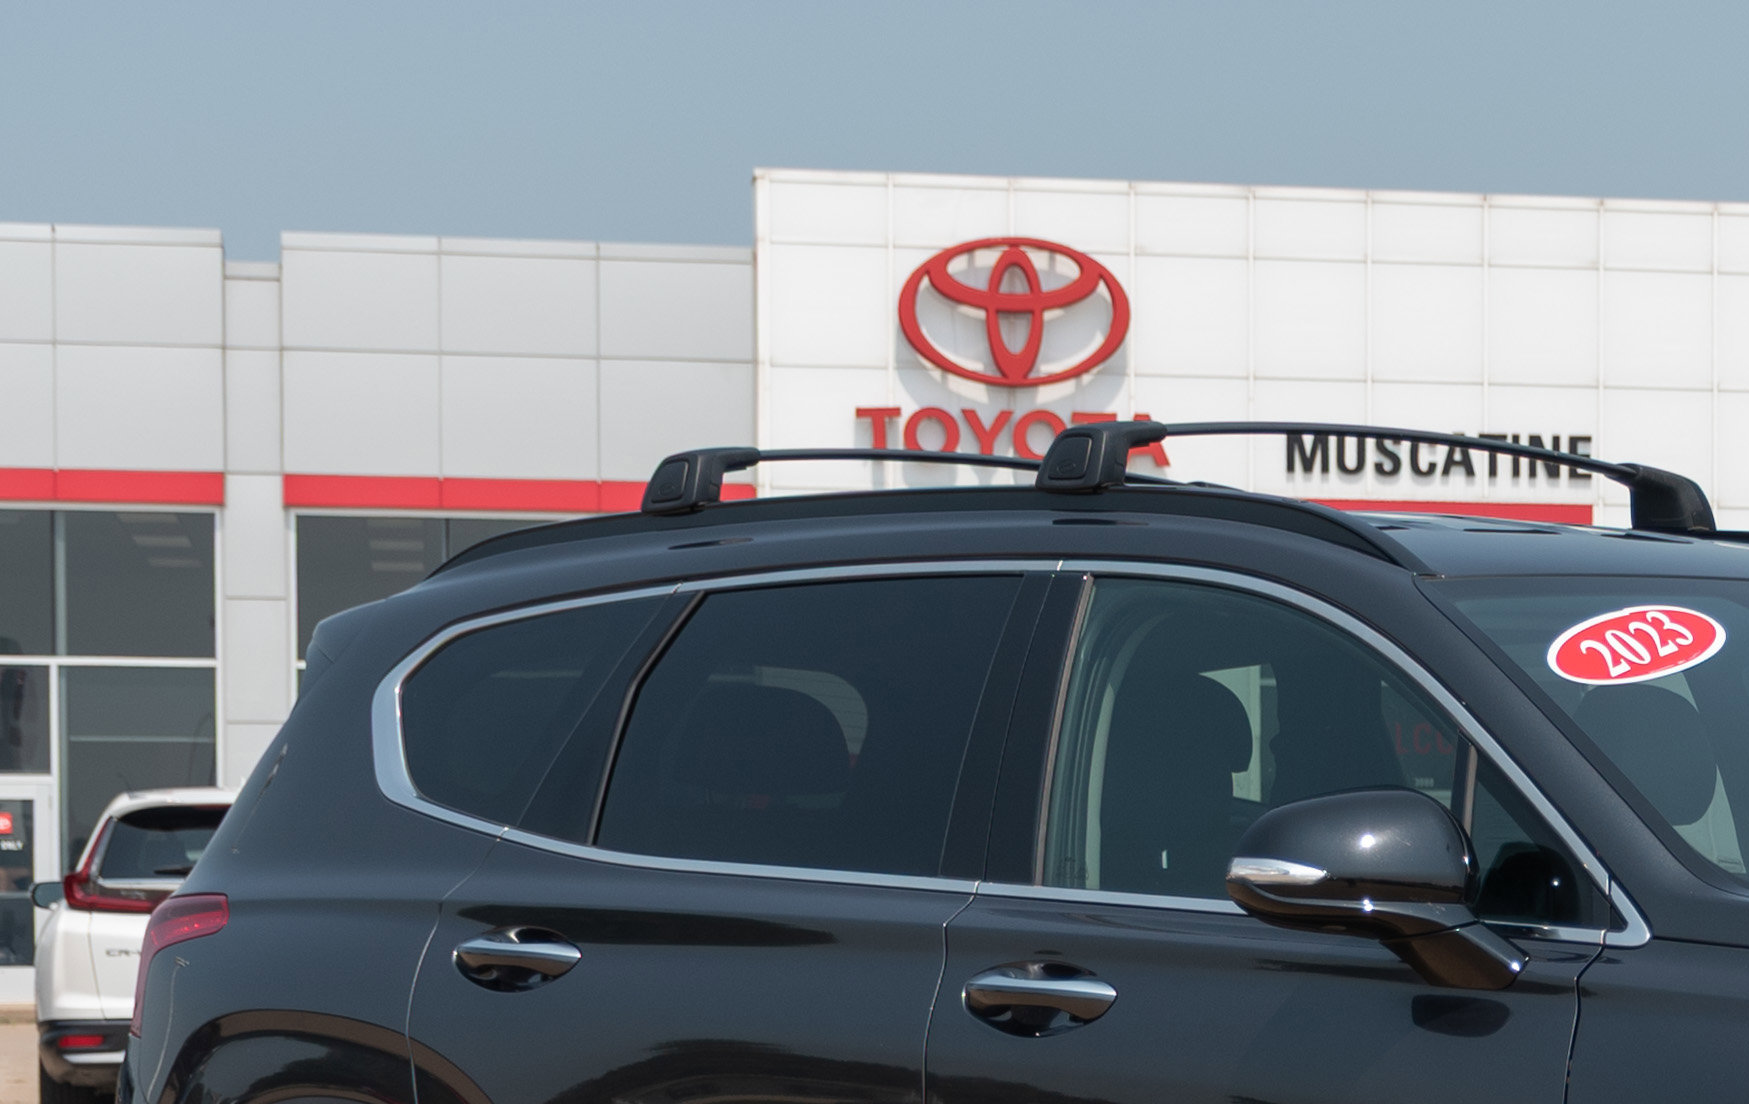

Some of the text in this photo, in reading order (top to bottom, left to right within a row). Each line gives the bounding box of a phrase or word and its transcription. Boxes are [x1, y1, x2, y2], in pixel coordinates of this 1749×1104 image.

[856, 407, 1170, 467] TOYOA
[1286, 432, 1593, 479] MUSCATINE
[1580, 611, 1694, 678] 2023
